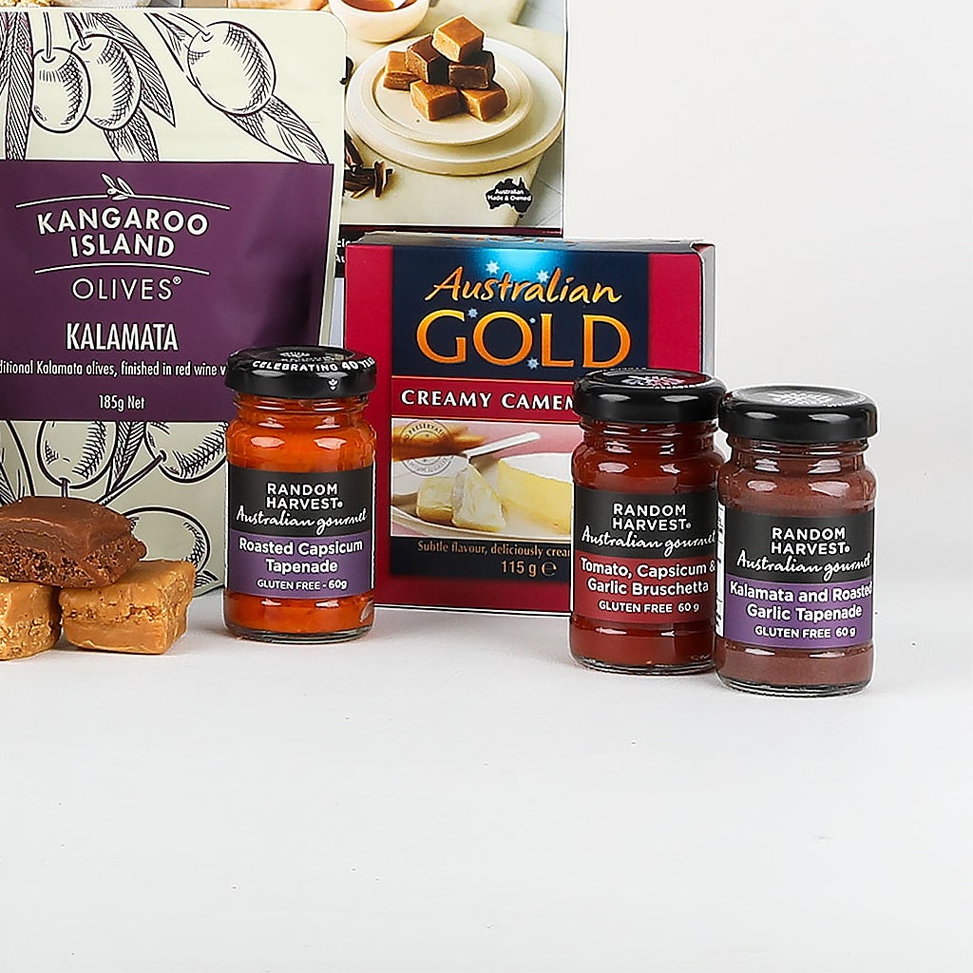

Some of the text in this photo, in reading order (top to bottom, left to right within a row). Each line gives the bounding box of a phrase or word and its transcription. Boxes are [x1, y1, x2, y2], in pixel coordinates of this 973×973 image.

[36, 206, 209, 236] KANGAROO
[69, 233, 176, 258] ISLAND
[423, 266, 622, 304] Australian
[65, 322, 179, 351] KALAMATA
[415, 308, 632, 369] GOLD
[36, 359, 84, 376] Kalamata
[85, 360, 119, 378] olives,
[120, 360, 160, 377] finished
[162, 361, 172, 376] in
[174, 361, 191, 377] red
[193, 361, 217, 377] wine
[341, 360, 358, 371] 40
[98, 393, 146, 413] 185g Net
[401, 388, 493, 409] CREAMY
[267, 482, 339, 496] RANDOM
[236, 504, 368, 535] Australian gourmet
[612, 503, 687, 517] RANDOM
[581, 525, 716, 557] Australian gourmet
[772, 527, 846, 541] RANDOM
[239, 537, 364, 558] Roasted Capsicum
[417, 539, 449, 554] Subtle
[451, 540, 488, 555] flavour,
[490, 542, 544, 560] deliciously
[265, 557, 339, 575] Tapenade
[501, 560, 525, 574] 115
[528, 563, 537, 577] g
[580, 556, 717, 581] Tomato, Capsicum &
[736, 549, 872, 582] Australian gourmet
[256, 578, 348, 591] GLUTEN FREE 60g
[587, 578, 709, 597] Garlic Bruschetta
[729, 581, 873, 603] Kalamata and Roasted
[598, 600, 641, 613] GLUTEN
[643, 602, 673, 614] FREE
[746, 603, 863, 624] Garlic Tapenade
[754, 625, 799, 639] GLUTEN
[802, 628, 832, 639] FREE
